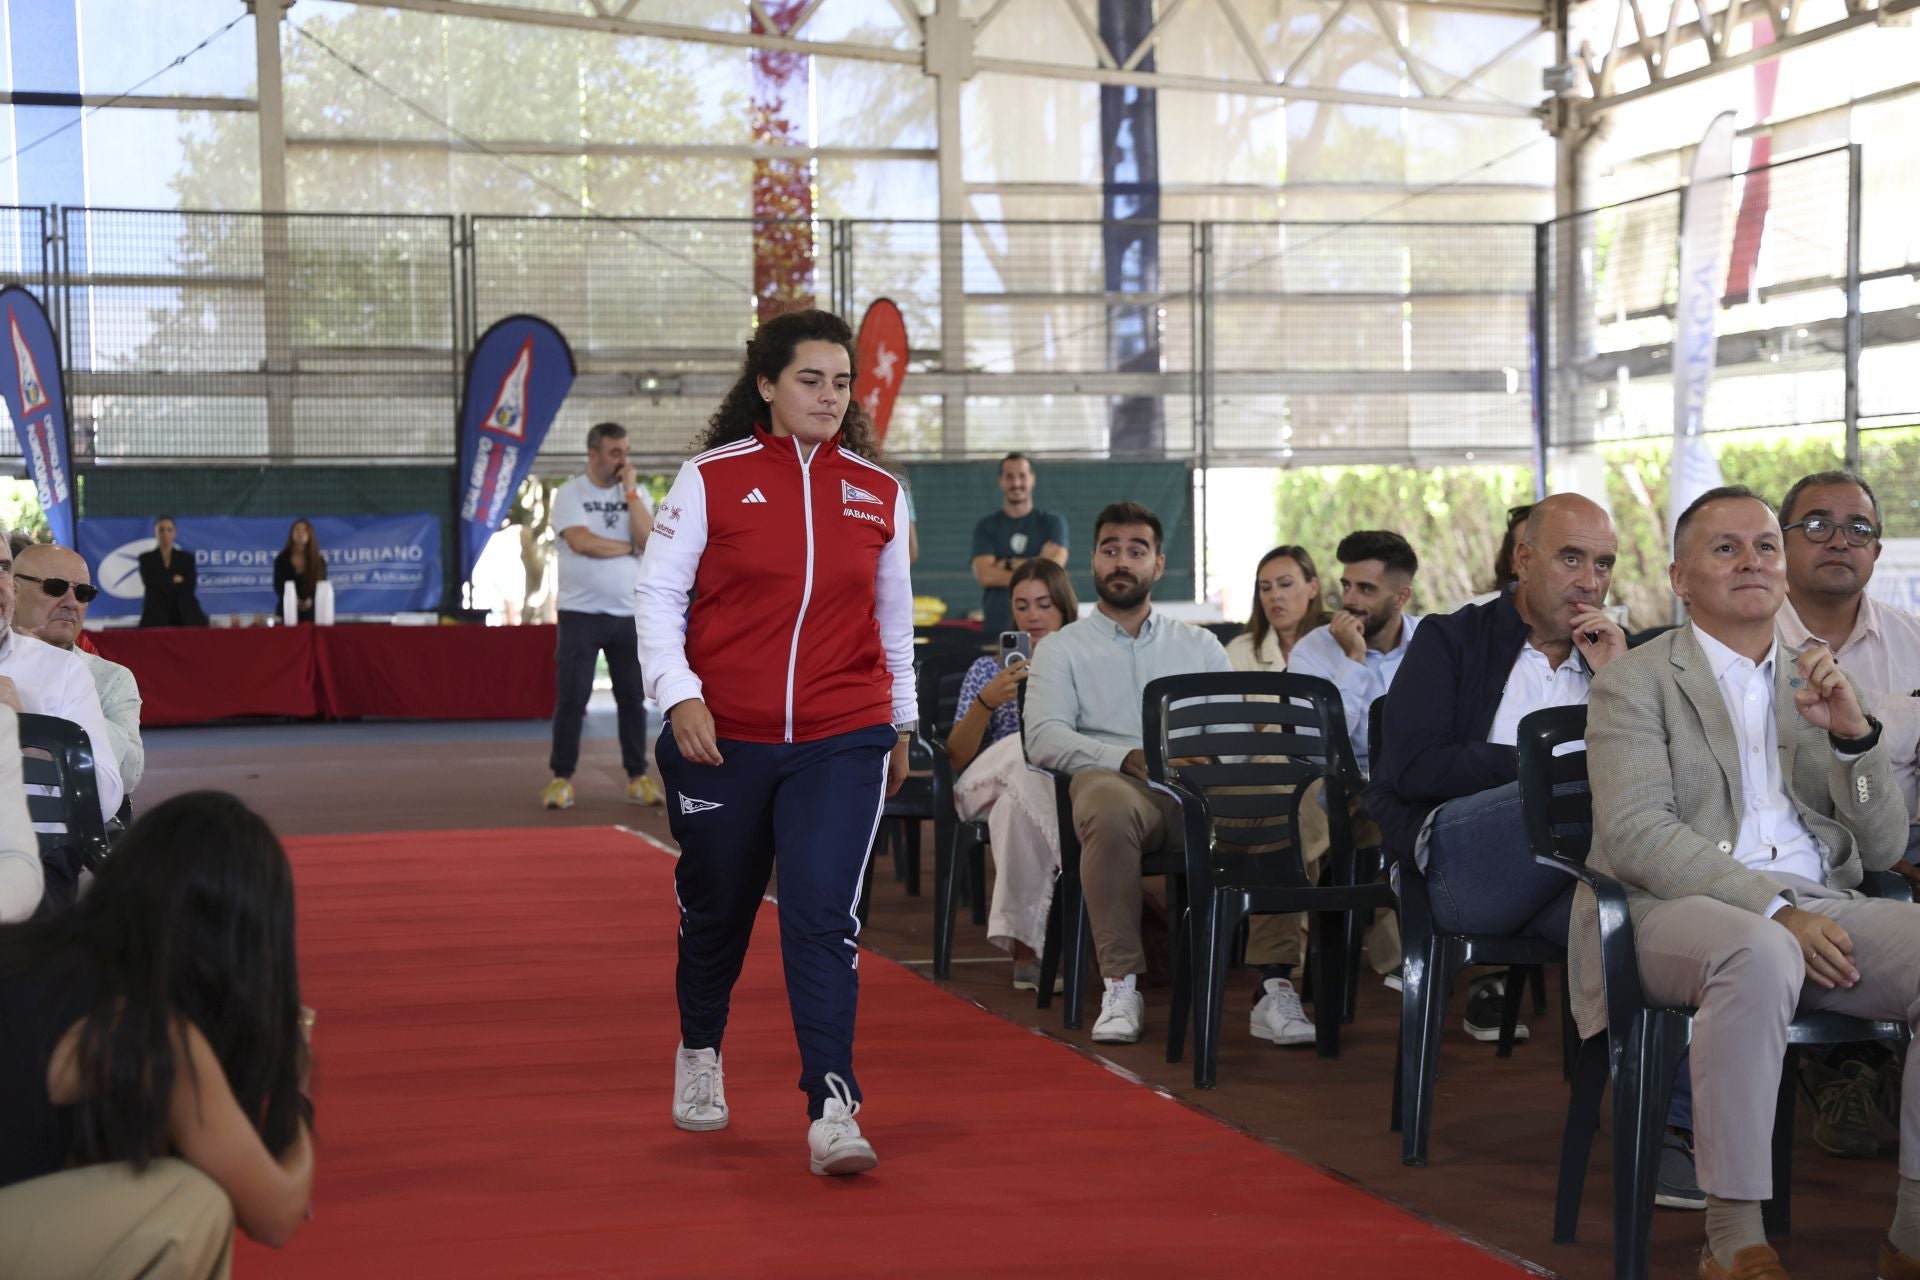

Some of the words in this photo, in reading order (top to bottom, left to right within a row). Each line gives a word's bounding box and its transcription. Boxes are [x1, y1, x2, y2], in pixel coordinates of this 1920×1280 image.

[583, 501, 629, 513] SILBO
[195, 549, 281, 566] DEPORT
[318, 544, 424, 564] STURIANO
